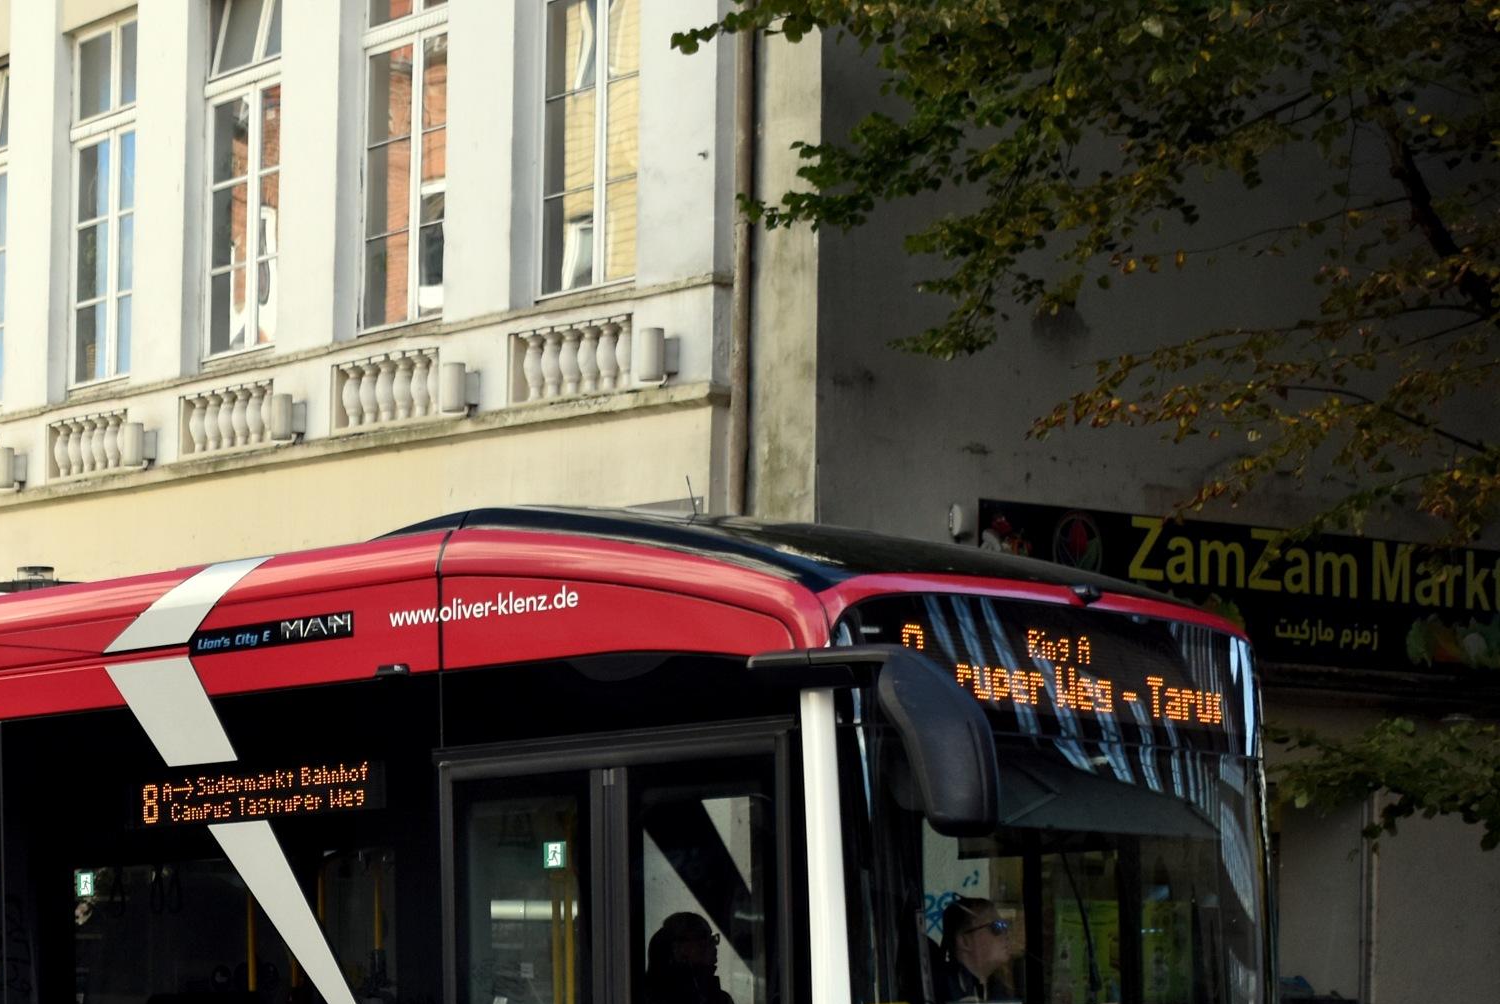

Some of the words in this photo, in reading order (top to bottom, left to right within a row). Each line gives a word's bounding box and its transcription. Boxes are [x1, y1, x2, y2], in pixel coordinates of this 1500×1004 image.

[1128, 515, 1358, 599] ZamZam
[389, 585, 579, 628] www.oliver-klenz.de
[234, 632, 259, 647] City
[262, 630, 271, 642] E
[280, 612, 352, 641] MAN
[1027, 629, 1069, 662] Ring
[1077, 635, 1091, 665] A
[1055, 665, 1113, 713] Weg
[142, 784, 159, 824] 8
[197, 769, 294, 797] Südermarkt
[300, 761, 368, 787] Bahnhof
[329, 788, 365, 809] Weg
